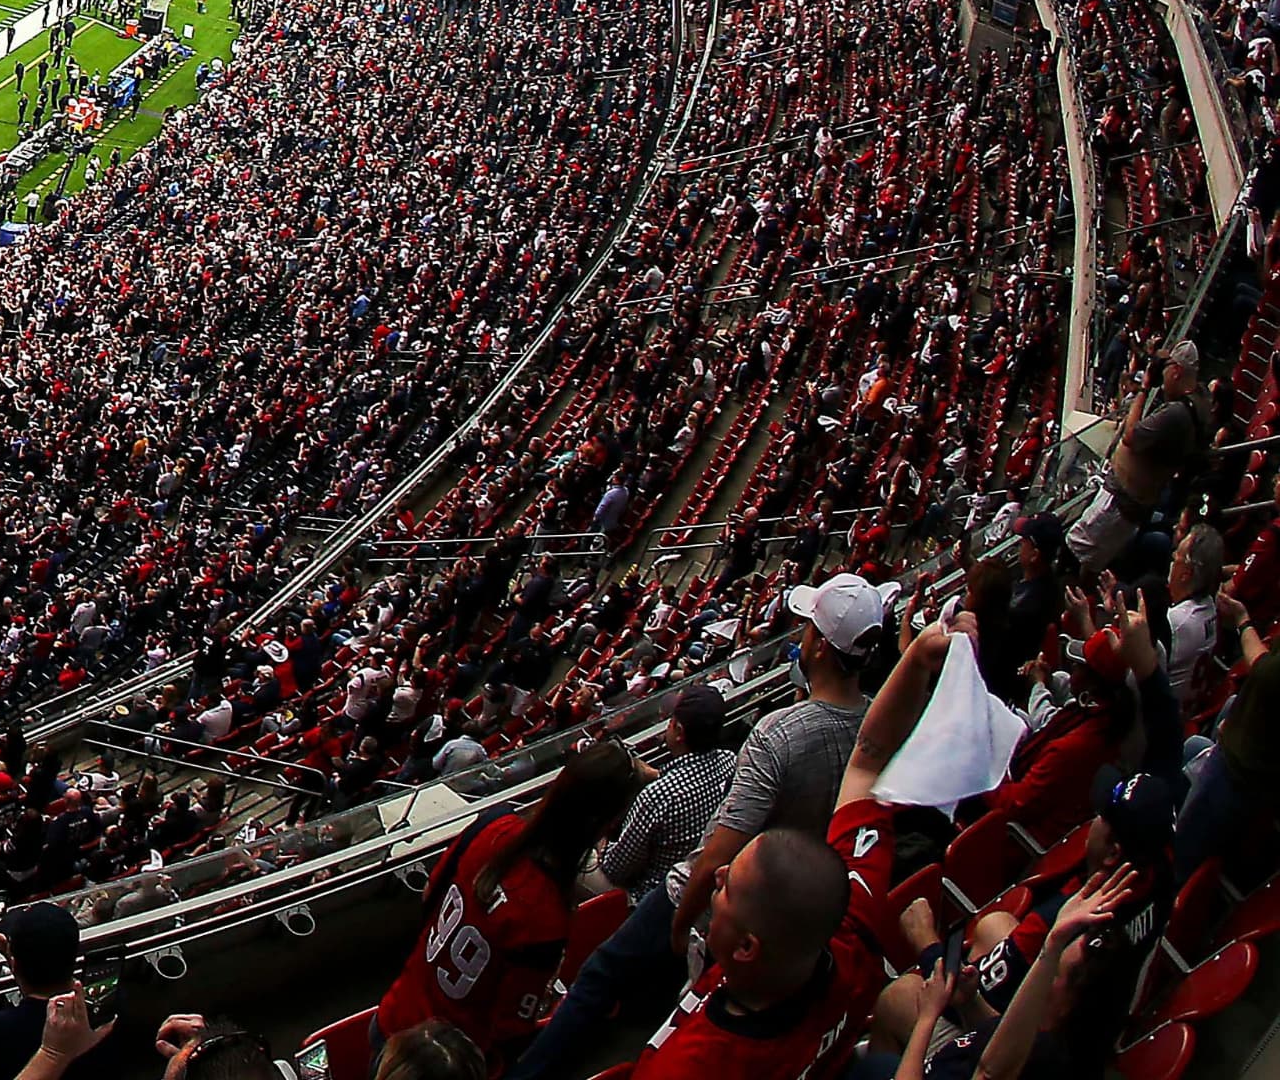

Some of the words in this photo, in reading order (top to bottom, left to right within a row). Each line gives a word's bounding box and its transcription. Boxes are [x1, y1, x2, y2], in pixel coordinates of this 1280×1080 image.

[852, 826, 879, 858] 4
[425, 883, 492, 1001] 99
[980, 937, 1011, 991] 99
